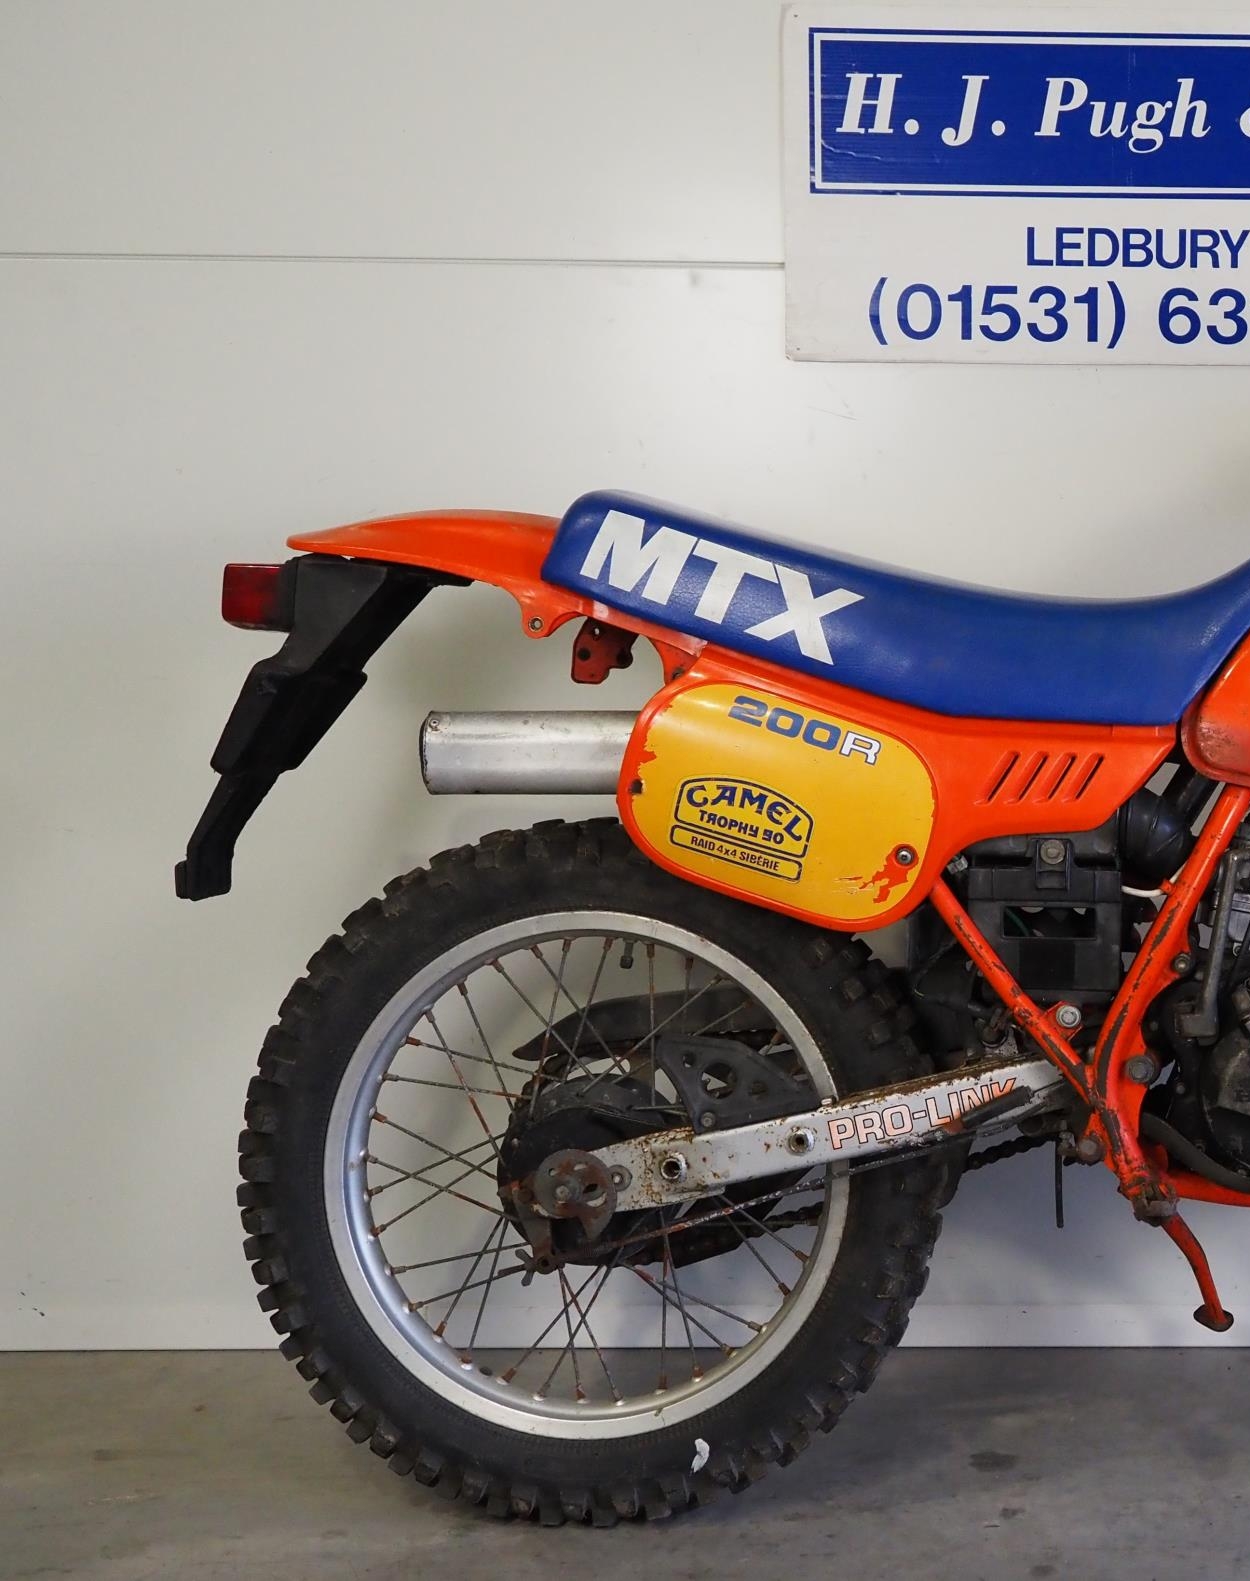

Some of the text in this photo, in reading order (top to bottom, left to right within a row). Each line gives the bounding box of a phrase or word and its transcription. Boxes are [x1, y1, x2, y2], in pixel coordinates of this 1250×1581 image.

[836, 72, 920, 135] H.
[941, 75, 1006, 146] J.
[1034, 77, 1210, 153] Pugh
[1025, 226, 1250, 269] LEDBURY
[867, 277, 1125, 349] (01531)
[579, 509, 865, 665] MTX
[727, 695, 881, 765] 200R
[686, 784, 803, 842] CAMEL
[699, 809, 760, 839] TROPHY
[690, 836, 716, 851] RAID
[716, 845, 737, 858] 4x4
